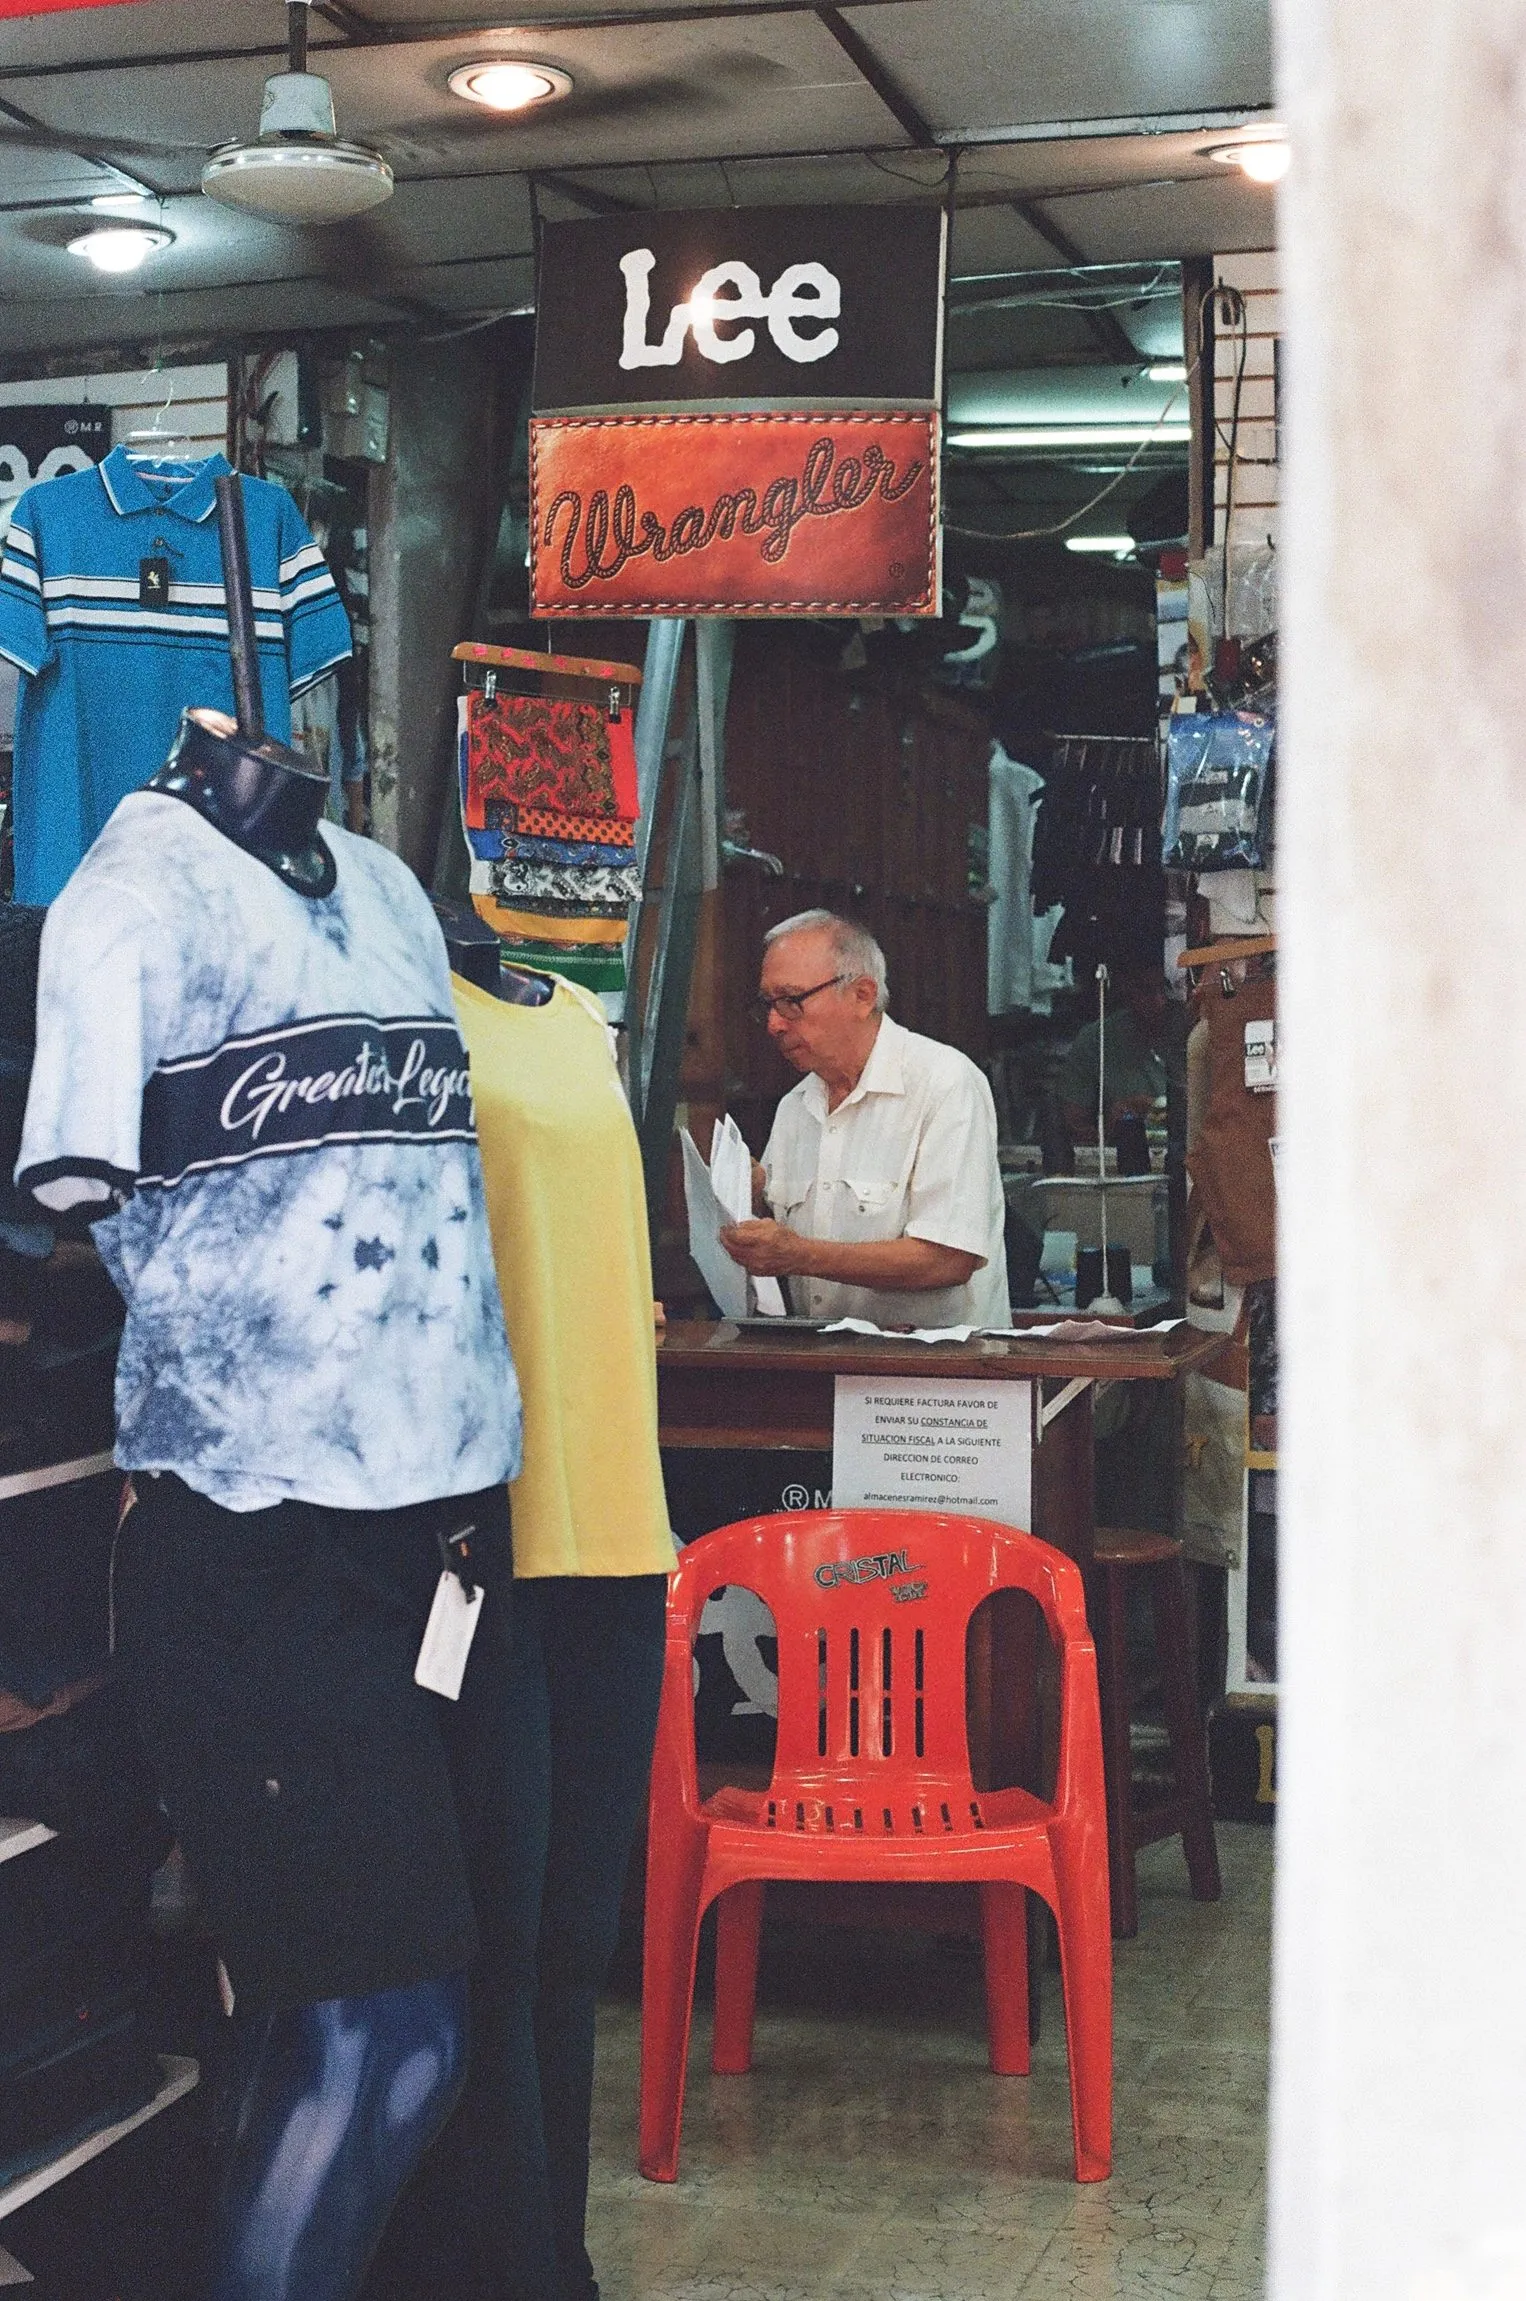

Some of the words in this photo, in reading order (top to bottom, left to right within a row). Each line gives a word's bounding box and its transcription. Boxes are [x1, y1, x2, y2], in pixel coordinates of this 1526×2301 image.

[619, 248, 841, 370] Lee
[544, 437, 925, 590] Wrangler
[864, 1396, 872, 1405] SI
[874, 1397, 914, 1406] REQUIERE
[917, 1399, 955, 1408] FACTURA
[957, 1400, 985, 1409] FAVOR
[987, 1401, 999, 1409] DE
[875, 1415, 905, 1424] ENVIAR
[907, 1417, 919, 1425] SU
[921, 1417, 974, 1428] CONSTANCIA
[976, 1419, 988, 1429] DE
[861, 1434, 906, 1444] SITUACION
[908, 1436, 935, 1446] FISCAL
[937, 1437, 944, 1445] A
[945, 1437, 956, 1446] LA
[957, 1438, 1001, 1447] SIGUIENTE
[883, 1453, 929, 1463] DIRECCION
[930, 1455, 941, 1464] DE
[943, 1456, 979, 1465] CORREO
[863, 1492, 999, 1506] almacenesramirez@hotmail.com
[813, 1548, 926, 1589] CRISTAL
